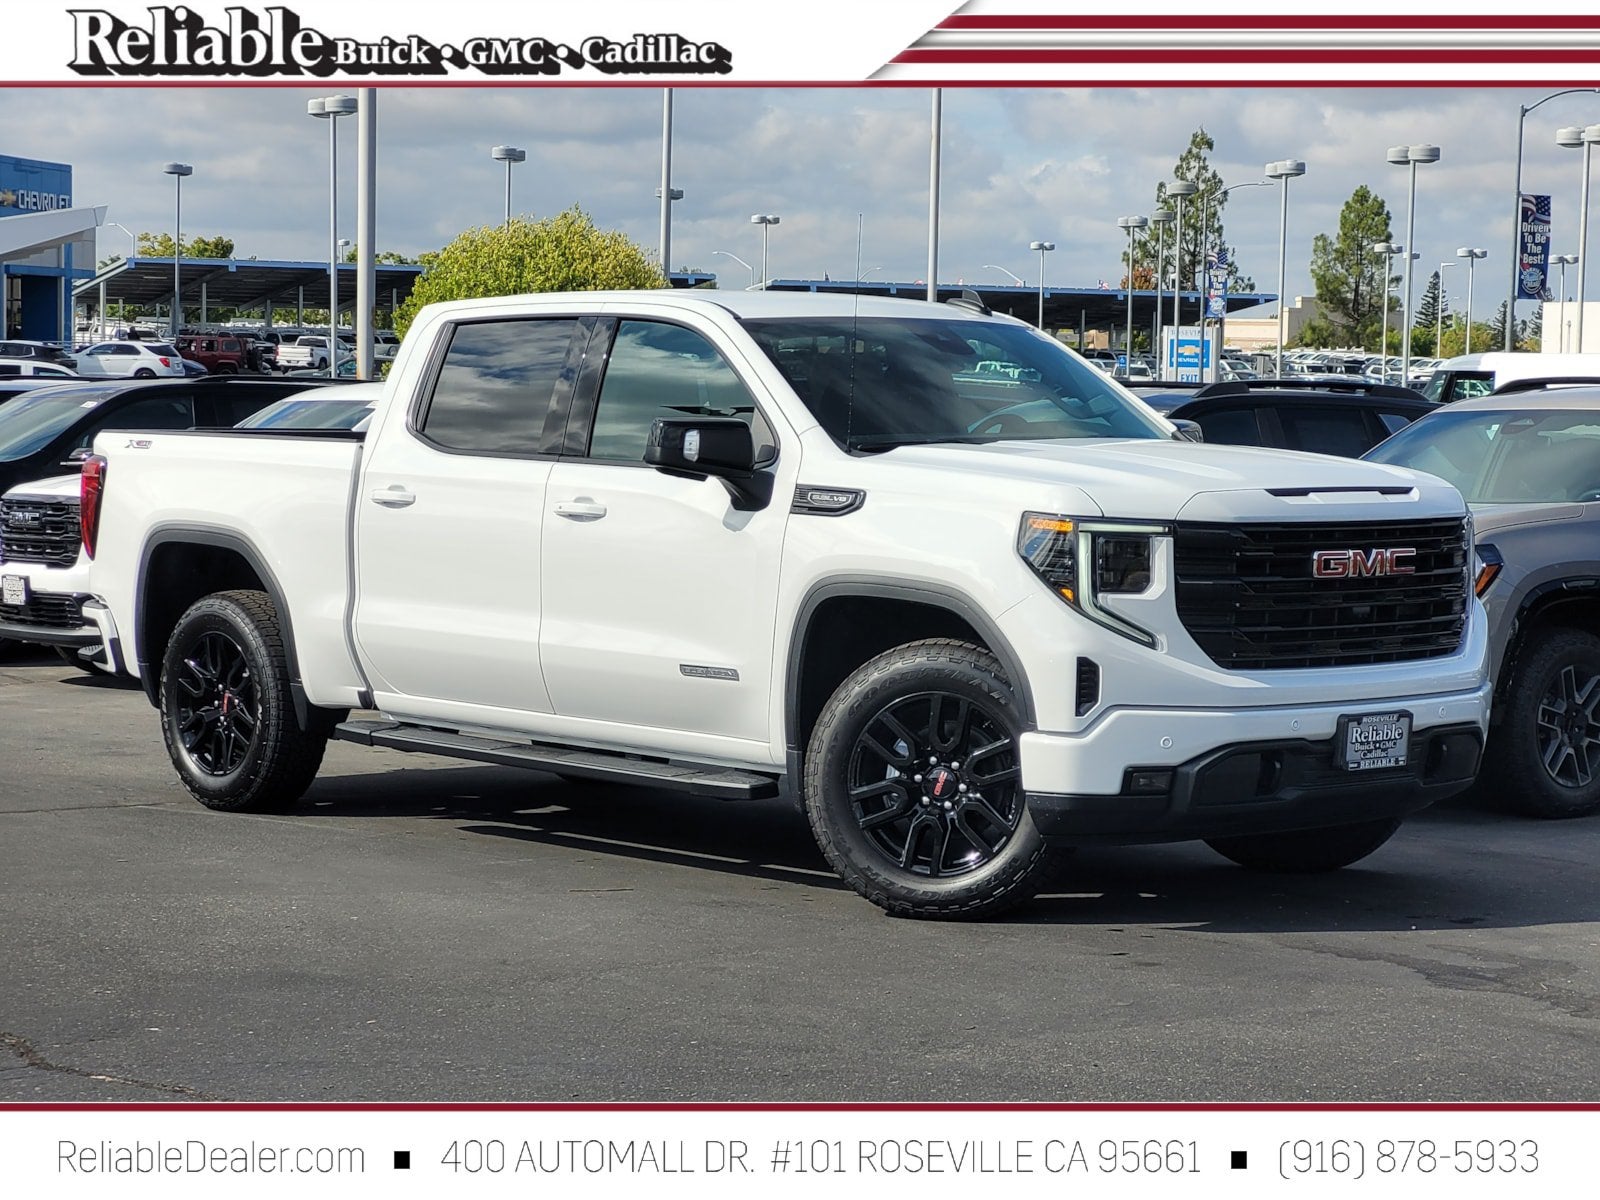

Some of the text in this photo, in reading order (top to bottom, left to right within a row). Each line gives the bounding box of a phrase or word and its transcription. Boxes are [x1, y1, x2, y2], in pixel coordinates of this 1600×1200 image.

[18, 190, 70, 210] CHEVROLET
[1522, 222, 1549, 232] Driven
[1524, 233, 1546, 243] To Be
[1527, 244, 1542, 254] The
[1523, 254, 1544, 264] Best!
[1180, 373, 1198, 382] EXIT
[1313, 548, 1417, 578] GMC
[1362, 714, 1398, 723] ROSEVILLE
[1351, 723, 1402, 743] Reliable
[1355, 740, 1397, 751] Buick GMC
[1360, 750, 1388, 759] Cadillac
[1360, 758, 1396, 769] RELIABLE
